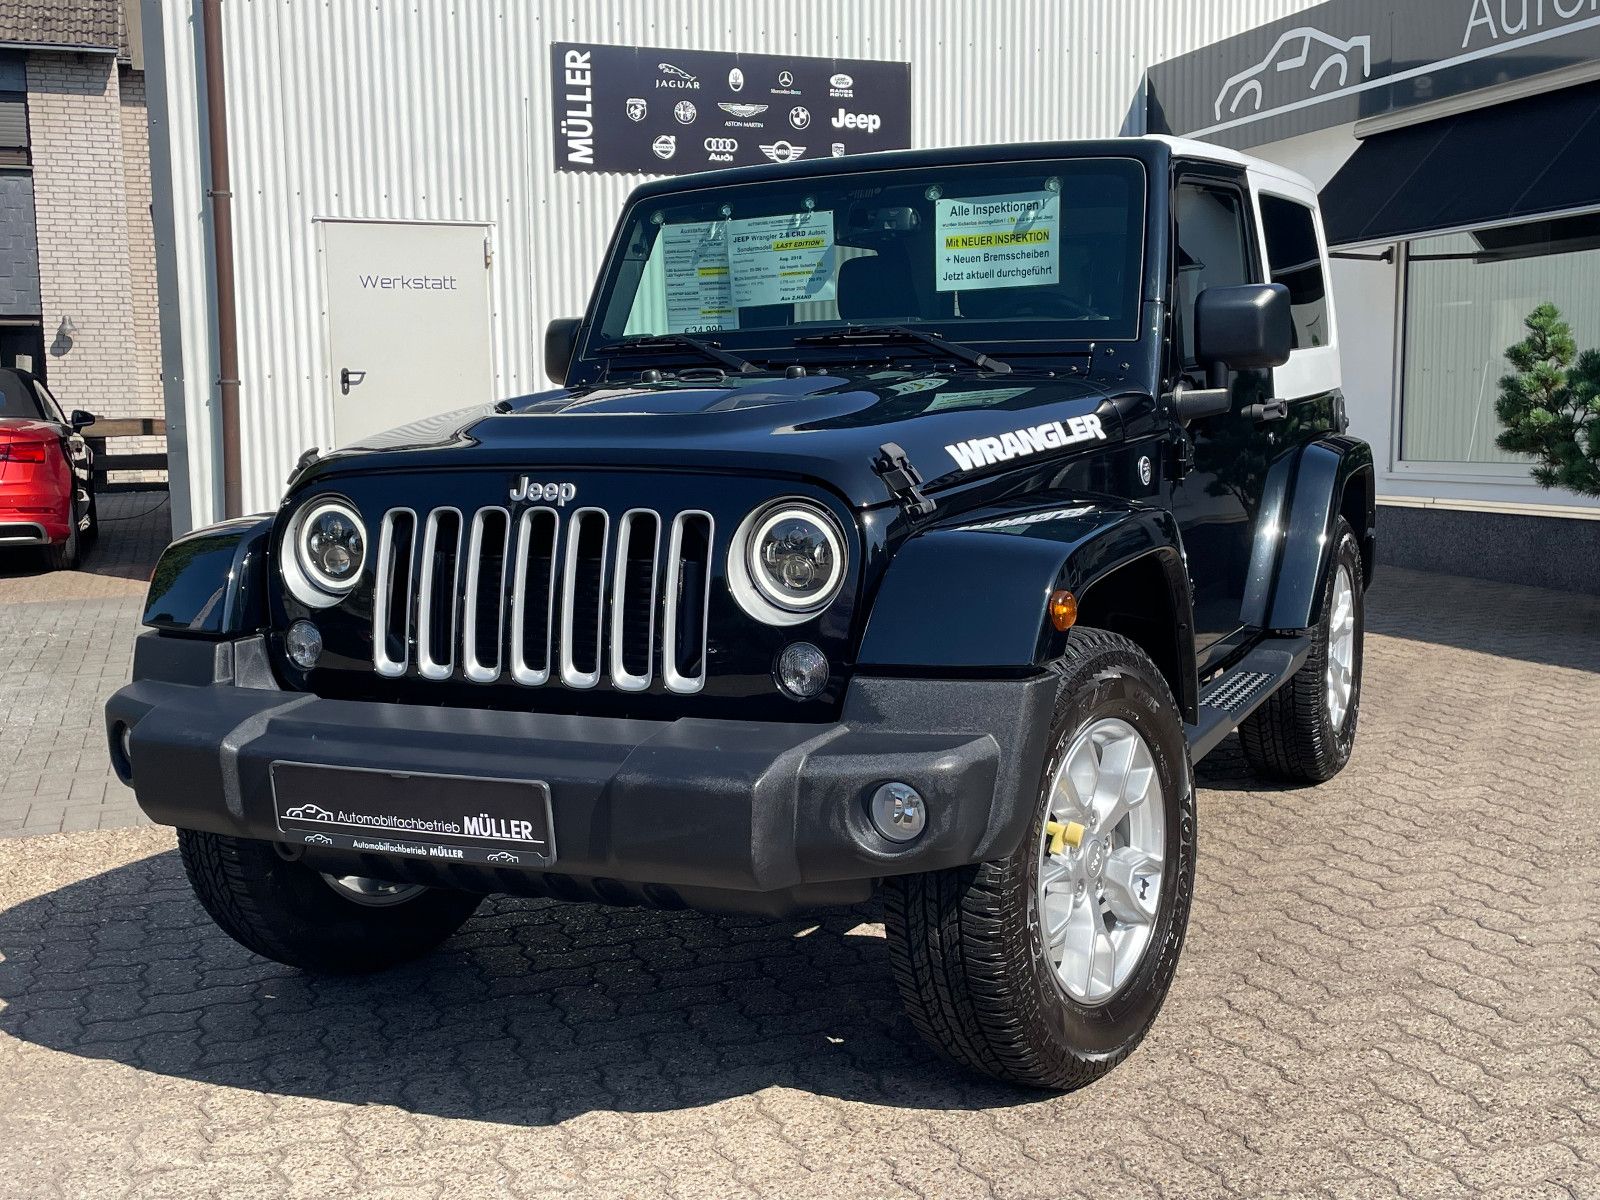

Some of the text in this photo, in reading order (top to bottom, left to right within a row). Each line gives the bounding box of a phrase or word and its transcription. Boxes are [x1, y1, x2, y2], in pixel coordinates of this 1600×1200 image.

[655, 79, 700, 89] JAGUAR
[561, 50, 594, 165] MÜLLER
[831, 108, 881, 133] Jeep
[708, 153, 734, 162] Audi
[775, 148, 790, 156] MINI
[950, 205, 970, 217] Alle
[972, 201, 1039, 217] Inspektionen
[945, 231, 1050, 248] Mit NEUER INSPEKTION
[737, 244, 773, 253] Sondermodell
[953, 254, 981, 264] Neuen
[983, 250, 1050, 262] Bremsscheiben
[943, 266, 1052, 281] Jetzt aktuell durchgeführt
[359, 275, 457, 290] Werkstatt
[944, 413, 1107, 471] WRANGLER
[509, 476, 576, 507] Jeep
[337, 810, 533, 840] Automobilfachbetrieb MÜLLER
[353, 839, 463, 859] Automobilfachbetrieb MÜLLER
